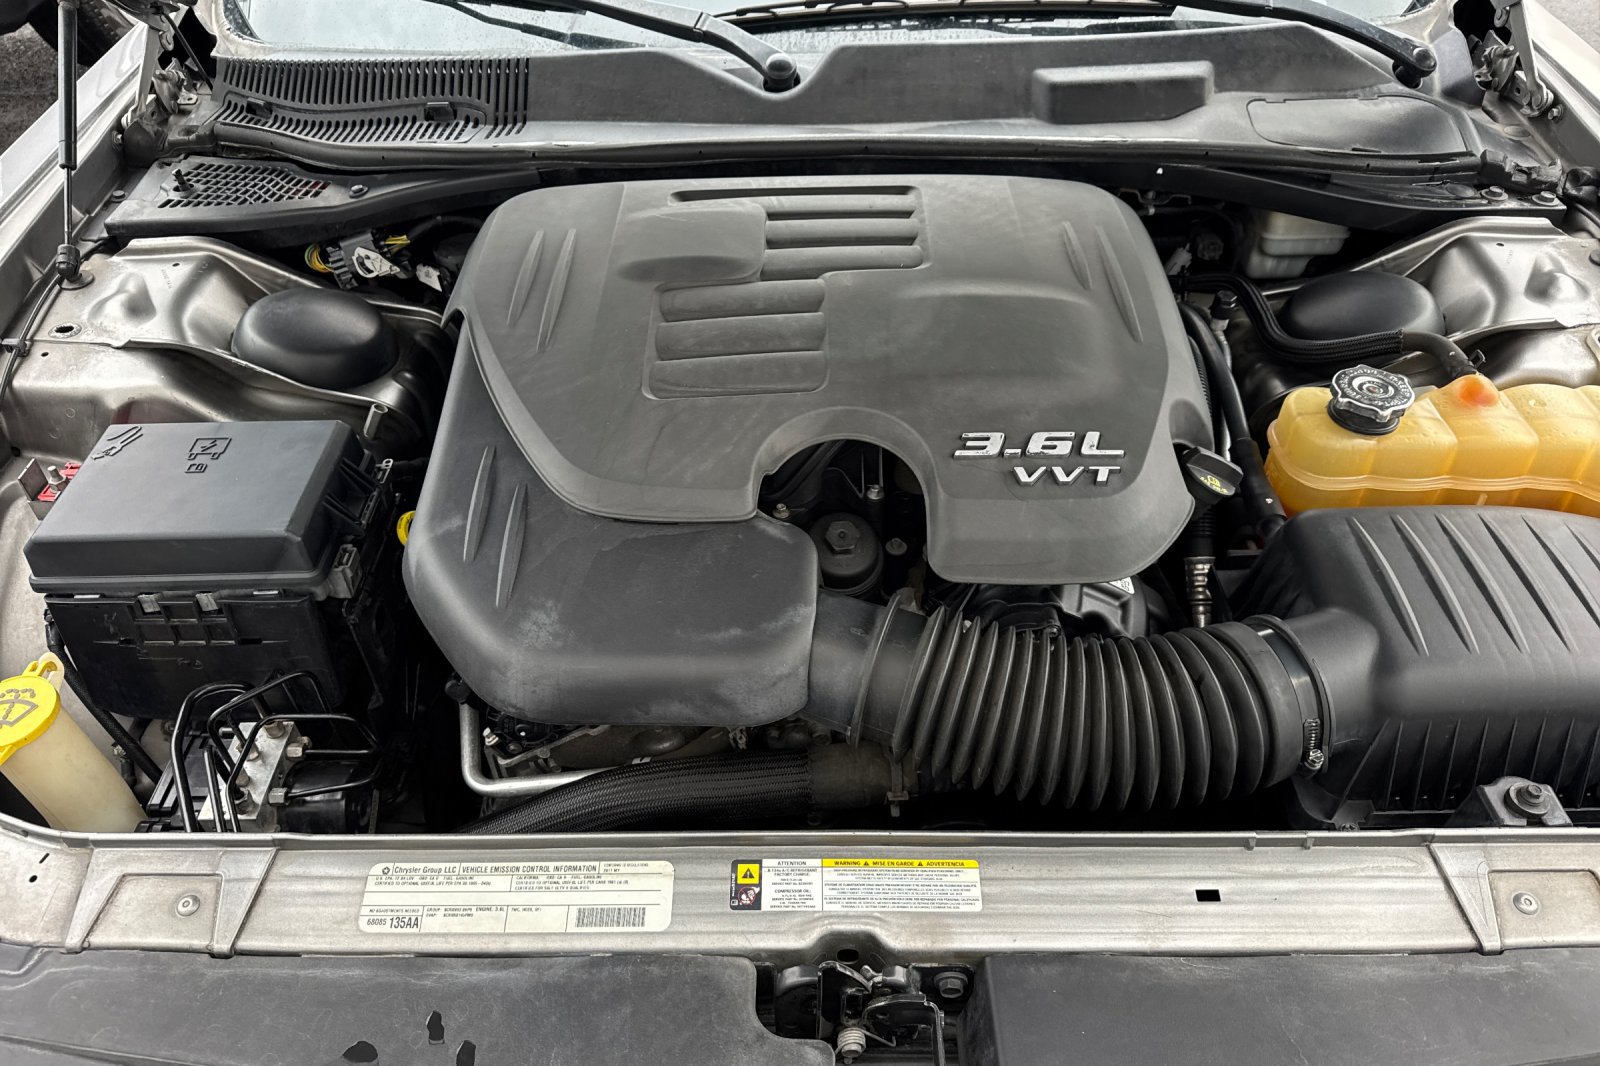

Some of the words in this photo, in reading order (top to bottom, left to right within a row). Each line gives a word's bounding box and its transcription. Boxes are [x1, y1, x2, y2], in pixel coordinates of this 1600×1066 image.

[953, 431, 1125, 458] 3.6L
[1012, 465, 1121, 486] VVT
[394, 866, 421, 875] Chrysler
[422, 866, 442, 874] Group
[390, 917, 419, 928] 135AA
